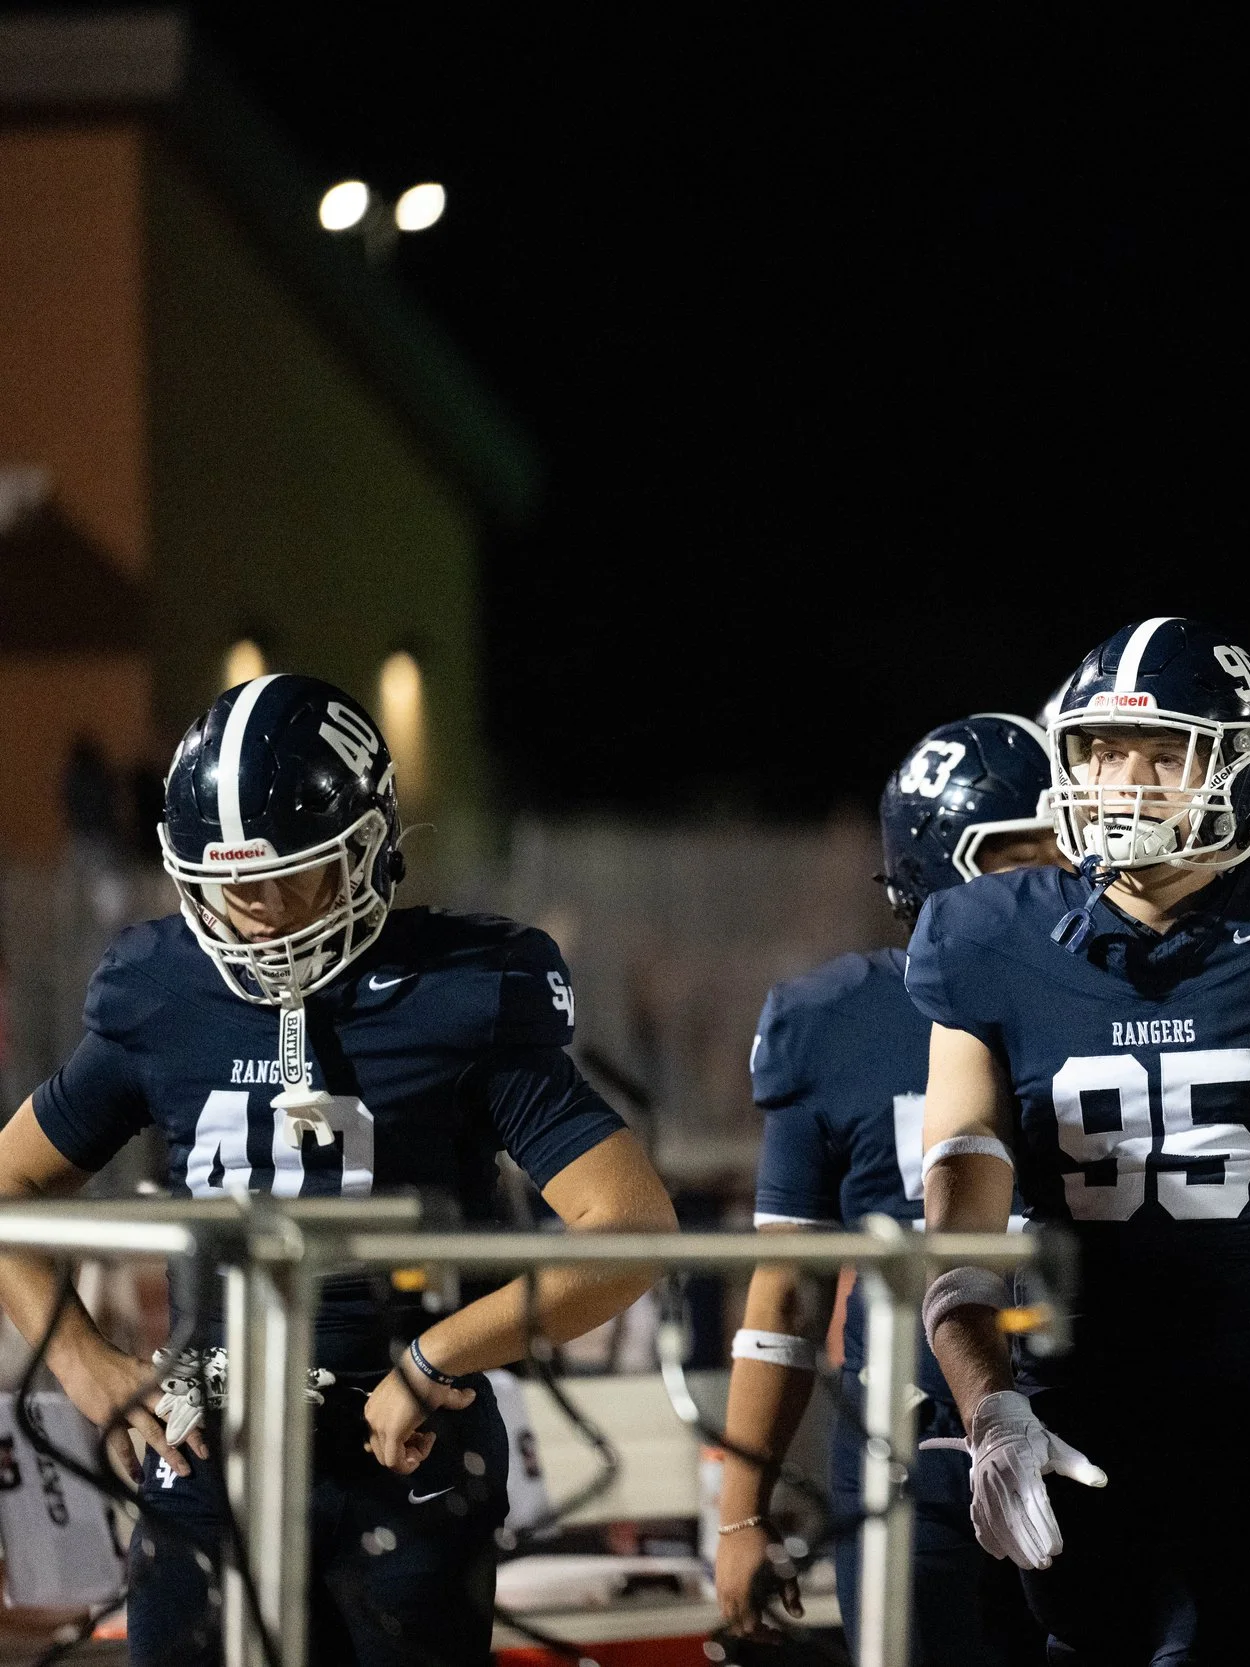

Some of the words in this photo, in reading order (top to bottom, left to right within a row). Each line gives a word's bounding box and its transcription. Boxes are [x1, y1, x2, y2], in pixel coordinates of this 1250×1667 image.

[318, 702, 379, 777] 40
[286, 1017, 299, 1077] BATTLE
[1112, 1019, 1195, 1047] RANGERS
[230, 1059, 313, 1085] RANGS
[186, 1090, 374, 1199] 40
